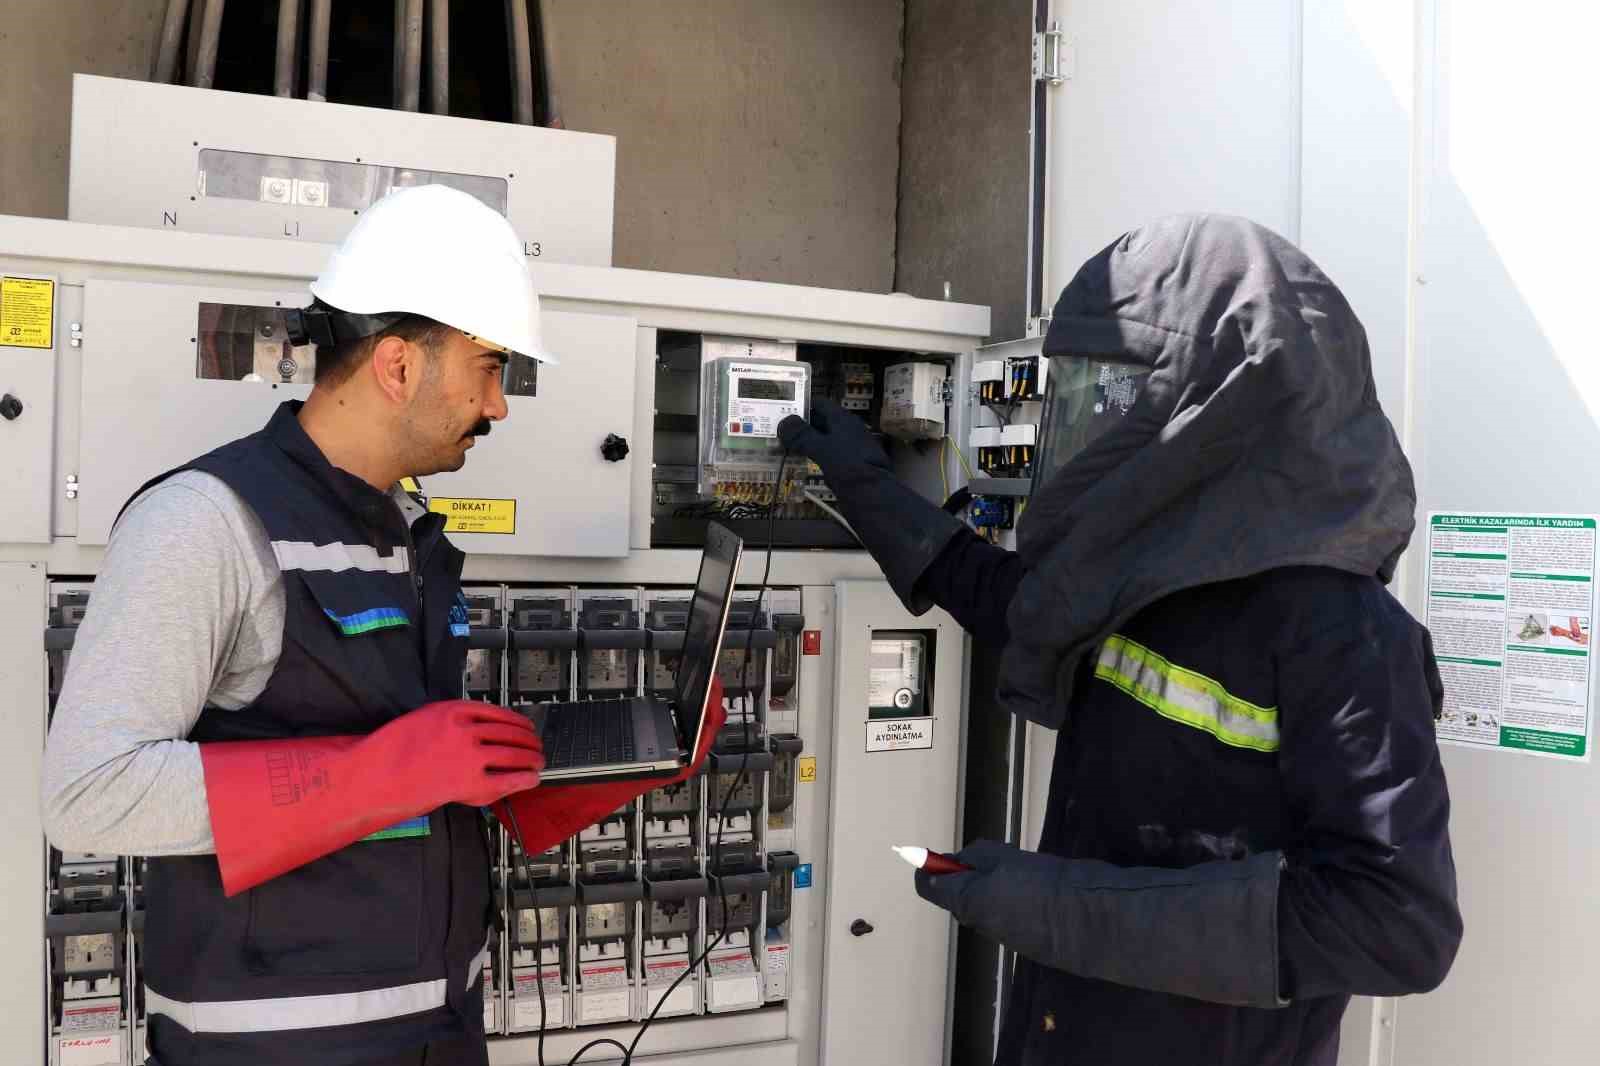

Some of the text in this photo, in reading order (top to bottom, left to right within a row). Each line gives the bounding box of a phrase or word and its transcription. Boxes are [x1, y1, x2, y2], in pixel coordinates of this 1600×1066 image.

[163, 211, 177, 226] N
[524, 242, 541, 257] L3
[1552, 519, 1584, 527] YARDIM
[887, 723, 912, 732] SOKAK
[875, 732, 923, 742] AYDINLATMA
[800, 767, 815, 778] L2
